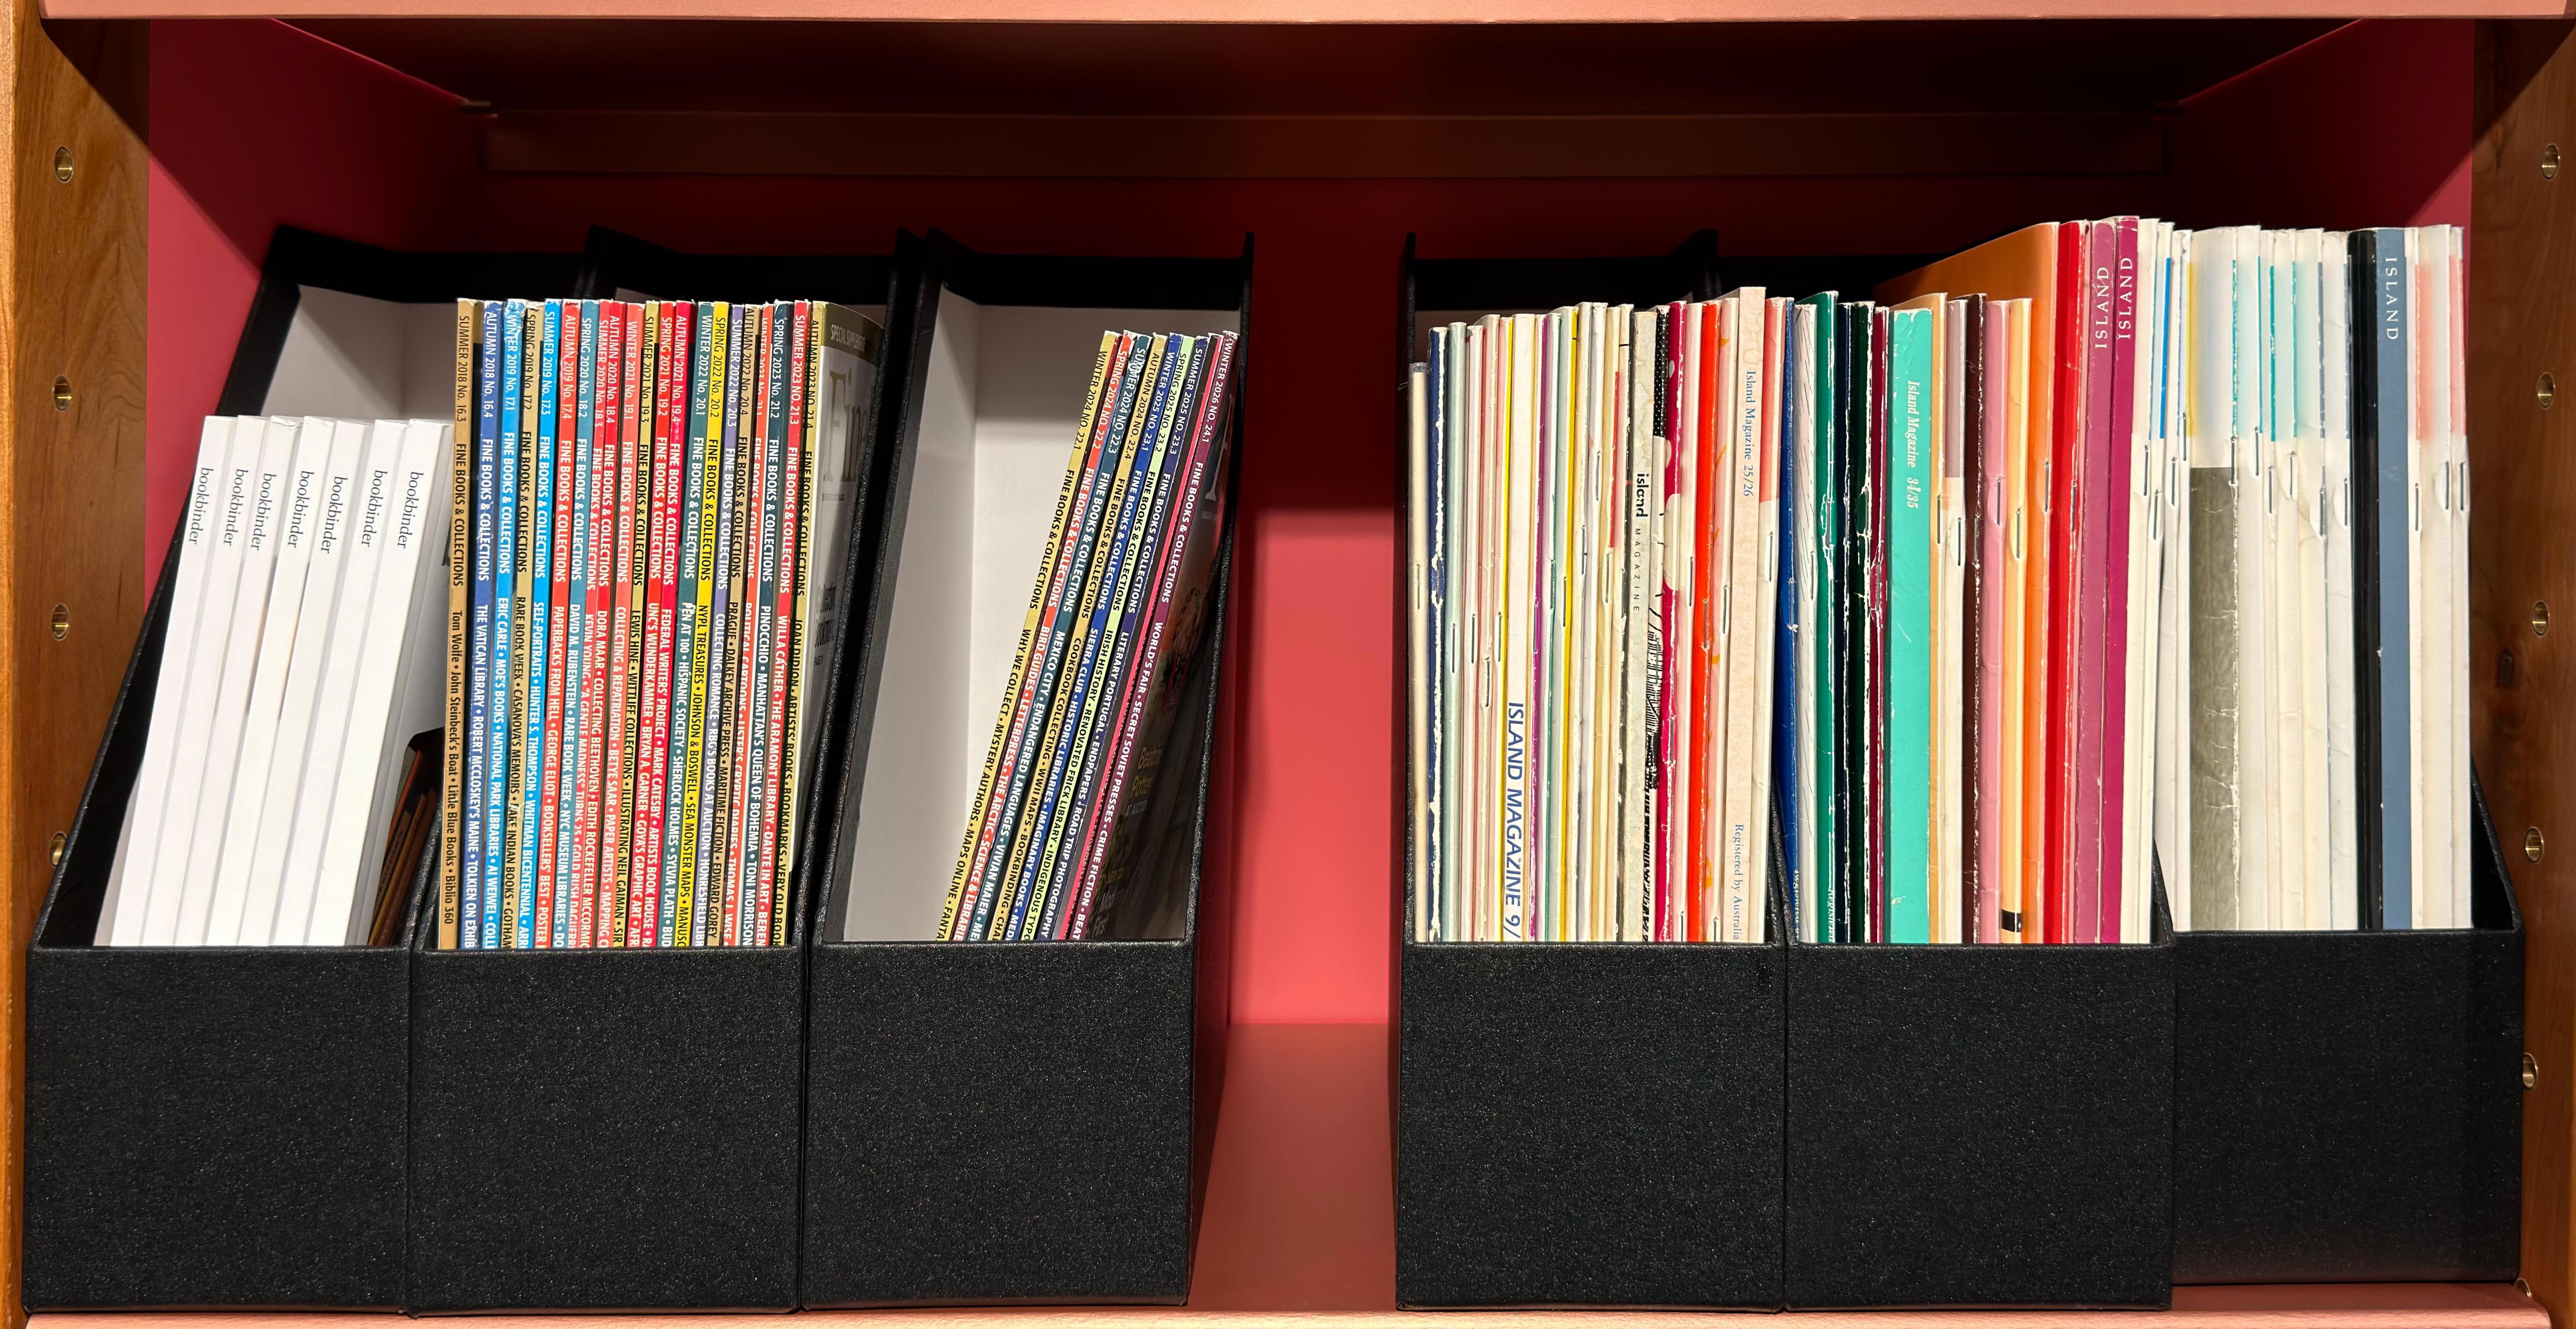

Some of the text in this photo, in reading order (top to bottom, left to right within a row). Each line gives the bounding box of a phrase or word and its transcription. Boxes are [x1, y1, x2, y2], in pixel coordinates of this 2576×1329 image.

[2095, 267, 2109, 348] ISLAND
[2118, 258, 2132, 339] ISLAND
[2385, 258, 2398, 339] ISLAND
[458, 316, 470, 359] SUMMER
[485, 311, 497, 355] AUTUMN
[543, 311, 555, 354] SUMMER
[700, 315, 713, 352] WINTER
[773, 318, 786, 354] SPRING
[457, 362, 468, 382] 2018
[484, 357, 495, 378] 2018
[542, 357, 553, 378] 2019
[698, 354, 709, 376] 2022
[772, 357, 782, 379] 2023
[457, 385, 467, 401] No.
[484, 381, 495, 397] No.
[541, 380, 552, 397] No.
[696, 379, 708, 395] No.
[771, 382, 782, 398] No.
[457, 405, 466, 422] 16.3
[483, 400, 494, 418] 16.4
[541, 400, 551, 415] 17.3
[695, 398, 706, 415] 20.1
[770, 400, 780, 418] 21.2
[481, 439, 493, 462] FINE
[539, 436, 550, 460] FINE
[692, 437, 704, 460] FINE
[768, 439, 779, 462] FINE
[1743, 371, 1756, 496] Island Magazine 25/26
[1905, 380, 1921, 508] Island Magazine 34/35
[456, 443, 466, 467] FINE
[454, 469, 466, 505] BOOKS
[480, 465, 492, 500] BOOKS
[538, 462, 549, 498] BOOKS
[689, 462, 702, 498] BOOKS
[766, 465, 778, 501] BOOKS
[1636, 474, 1649, 517] island
[189, 467, 213, 544] bookbinder
[224, 469, 249, 546] bookbinder
[251, 473, 277, 551] bookbinder
[288, 471, 314, 548] bookbinder
[321, 476, 348, 553] bookbinder
[361, 470, 387, 547] bookbinder
[397, 472, 424, 548] bookbinder
[452, 518, 465, 586] COLLECTIONS
[478, 513, 490, 581] COLLECTIONS
[535, 510, 548, 578] COLLECTIONS
[684, 511, 699, 579] COLLECTIONS
[762, 514, 775, 582] COLLECTIONS
[452, 610, 462, 631] Tom
[477, 604, 488, 623] THE
[680, 623, 691, 636] AT
[681, 602, 694, 621] PEN
[947, 351, 1107, 899] WINTER 2024 NO. 22.1 FINE BOOKS & COLLECTIONS WHY WE COLLECT MYSTERY AUTHORS MAPS ONLINE
[1081, 342, 1234, 907] WINTER 2026 NO. 24.1 FINE BOOKS & COLLECTIONS WORLD'S FAIR SECRET SOVIET PRESSES CRIME FICTION
[451, 634, 462, 663] Wolfe
[475, 625, 487, 665] VATICAN
[531, 602, 544, 677] SELF-PORTRAITS
[679, 638, 690, 653] 100
[758, 606, 771, 663] PINOCCHIO
[1031, 353, 1186, 913] SPRING 2025 NO. 23.2 FINE BOOKS & COLLECTIONS IRISH HISTORY RENOVATED FRICK LIBRARY INDIGENOUS
[450, 671, 462, 694] John
[473, 667, 486, 707] LIBRARY
[676, 662, 690, 706] HISPANIC
[529, 686, 541, 724] HUNTER
[753, 673, 768, 746] MANHATTAN'S
[449, 697, 461, 750] Steinbeck's
[471, 716, 484, 754] ROBERT
[528, 726, 539, 734] S.
[674, 708, 686, 747] SOCIETY
[1507, 702, 1523, 780] ISLAND
[448, 754, 459, 776] Boat
[526, 737, 538, 791] THOMPSON
[670, 756, 684, 805] SHERLOCK
[751, 749, 764, 783] QUEEN
[447, 785, 458, 809] Little
[469, 755, 482, 819] MCCLOSKEY'S
[750, 786, 762, 800] OF
[446, 812, 457, 834] Blue
[468, 821, 480, 852] MAINE
[522, 800, 536, 847] WHITMAN
[667, 807, 680, 845] HOLMES
[747, 802, 761, 852] BOHEMIA
[445, 836, 457, 866] Books
[1505, 788, 1522, 906] MAGAZINE
[465, 860, 478, 900] TOLKIEN
[519, 850, 533, 918] BICENTENNIAL
[665, 854, 677, 886] SYLVIA
[745, 861, 757, 886] TONI
[1732, 824, 1744, 940] Registered by Australia
[445, 875, 456, 904] Biblio
[663, 888, 675, 918] PLATH
[444, 907, 454, 924] 360
[465, 903, 476, 917] ON
[742, 889, 756, 946] MORRISON
